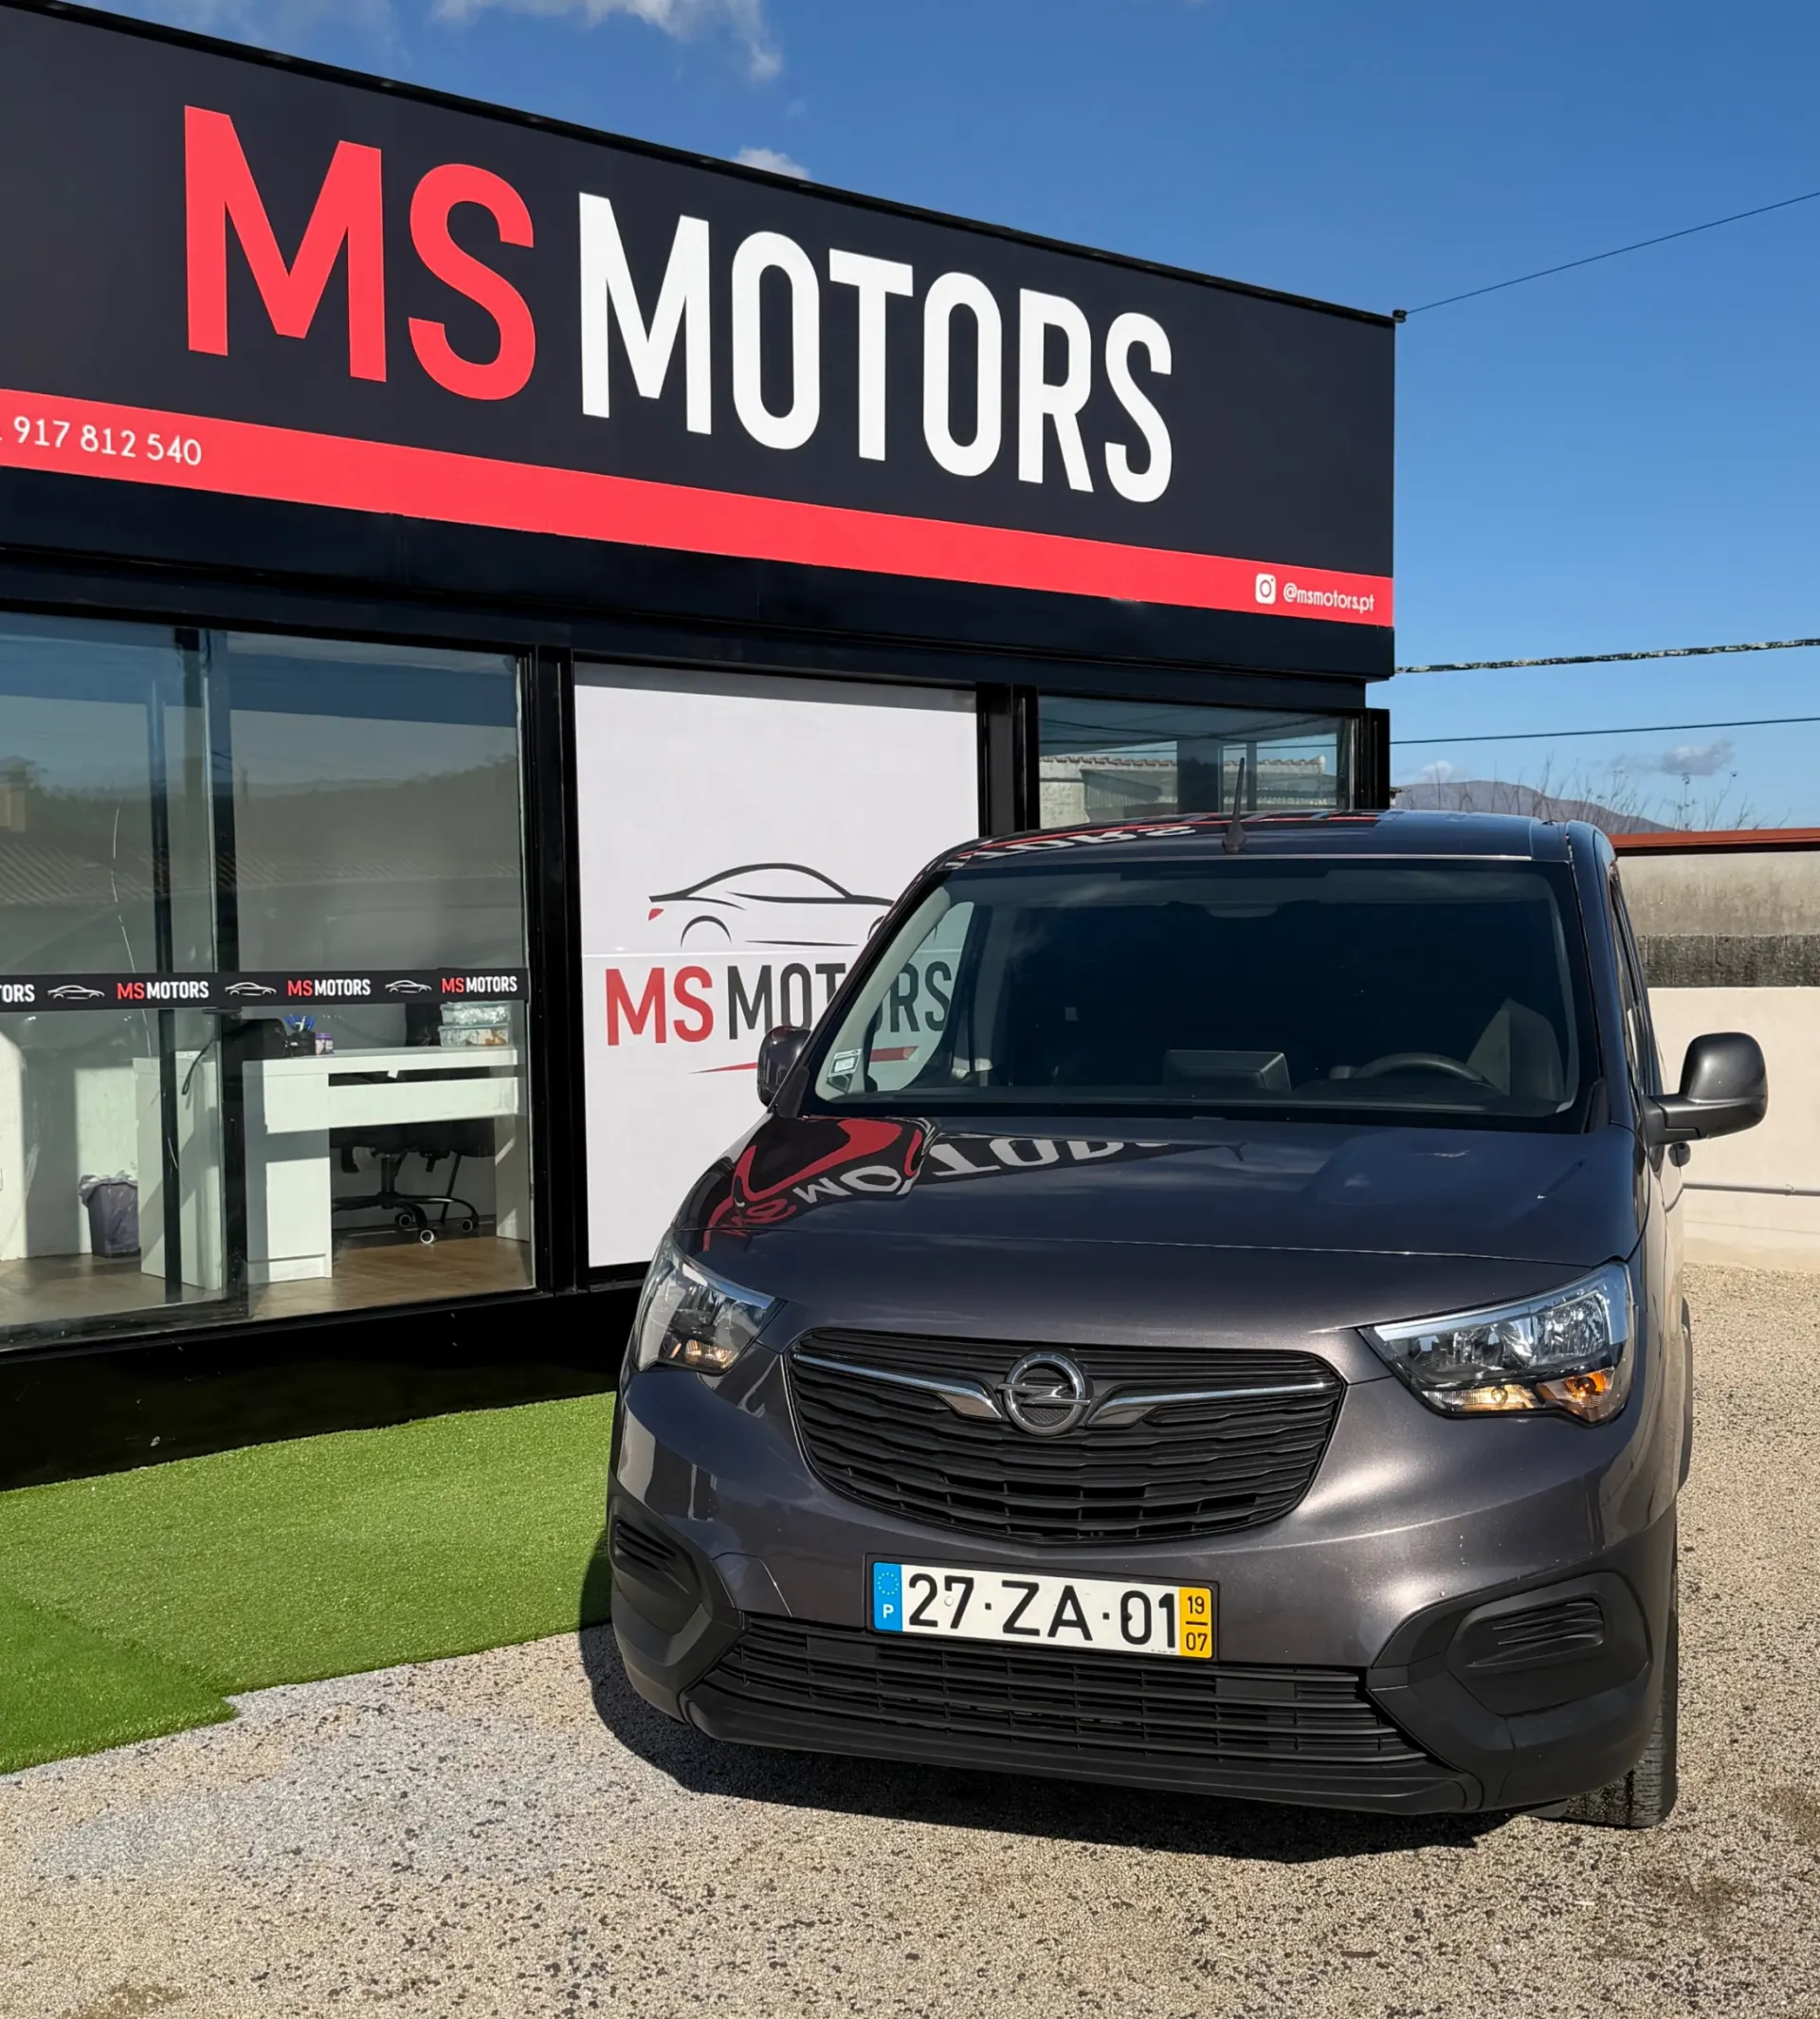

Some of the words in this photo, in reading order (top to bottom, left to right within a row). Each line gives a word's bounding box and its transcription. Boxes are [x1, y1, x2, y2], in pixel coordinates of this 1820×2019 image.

[184, 105, 536, 401] MS
[578, 191, 1173, 502] MOTORS
[13, 416, 70, 447] 917
[80, 425, 136, 458] 812
[147, 433, 202, 465] 540
[1283, 582, 1375, 614] @msmotors.pt
[0, 984, 35, 1003] ORS
[117, 982, 145, 1000] MS
[146, 981, 209, 999] MOTORS
[287, 979, 312, 996] MS
[314, 978, 371, 995] MOTORS
[441, 977, 464, 993] MS
[465, 975, 518, 992] MOTORS
[605, 965, 714, 1046] MS
[1187, 1595, 1205, 1615] 19
[1186, 1631, 1208, 1652] 07
